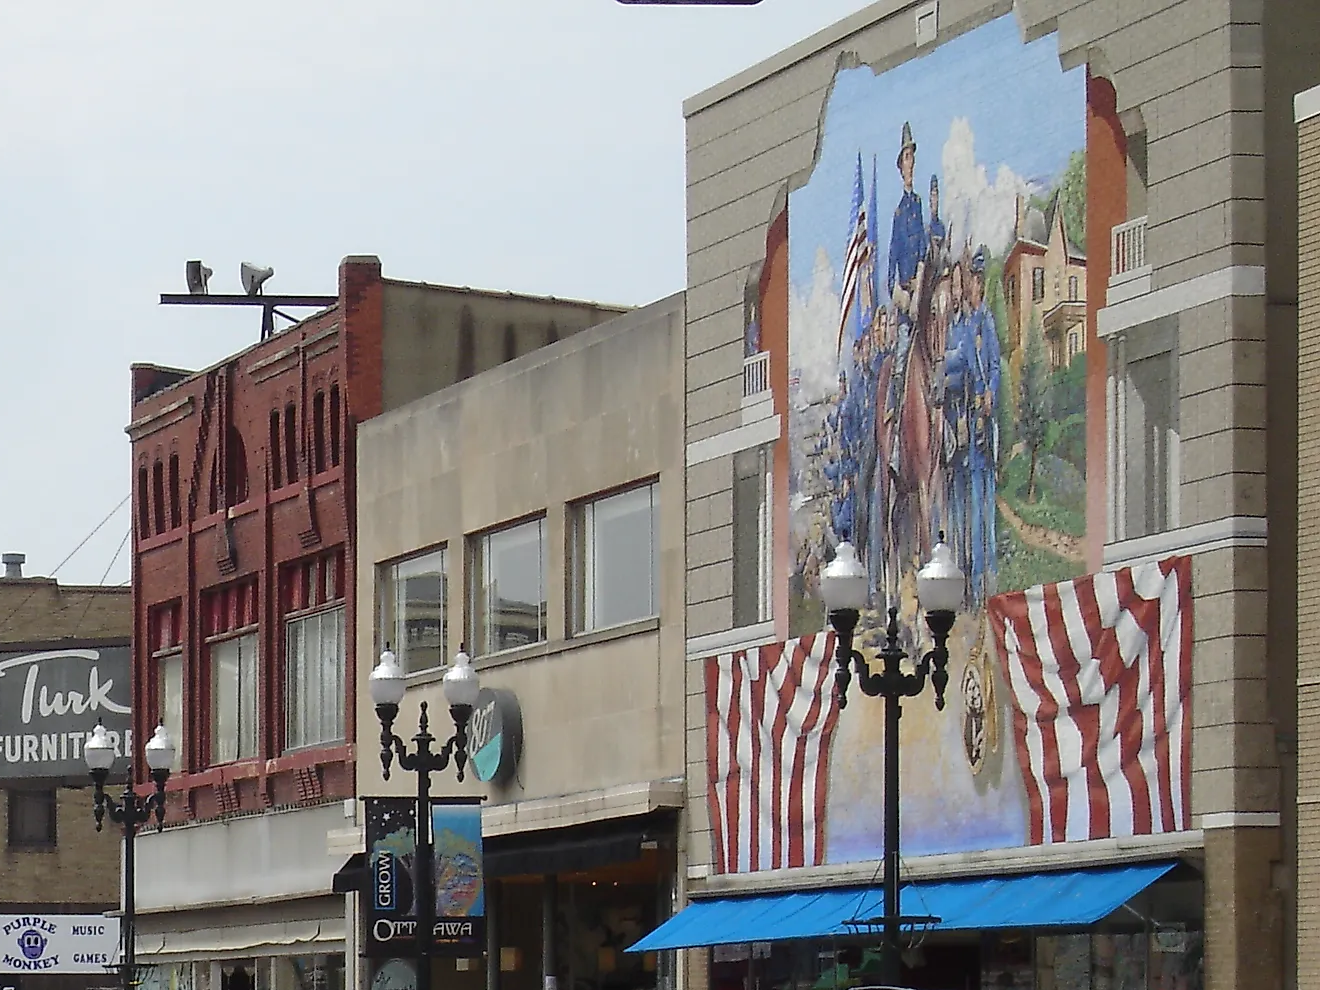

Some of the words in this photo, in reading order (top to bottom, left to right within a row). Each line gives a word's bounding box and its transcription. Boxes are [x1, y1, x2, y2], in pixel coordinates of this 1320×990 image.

[2, 916, 58, 936] PURPLE
[72, 926, 105, 936] MUSIC
[2, 953, 60, 971] MONKEY
[73, 953, 108, 964] GAMES
